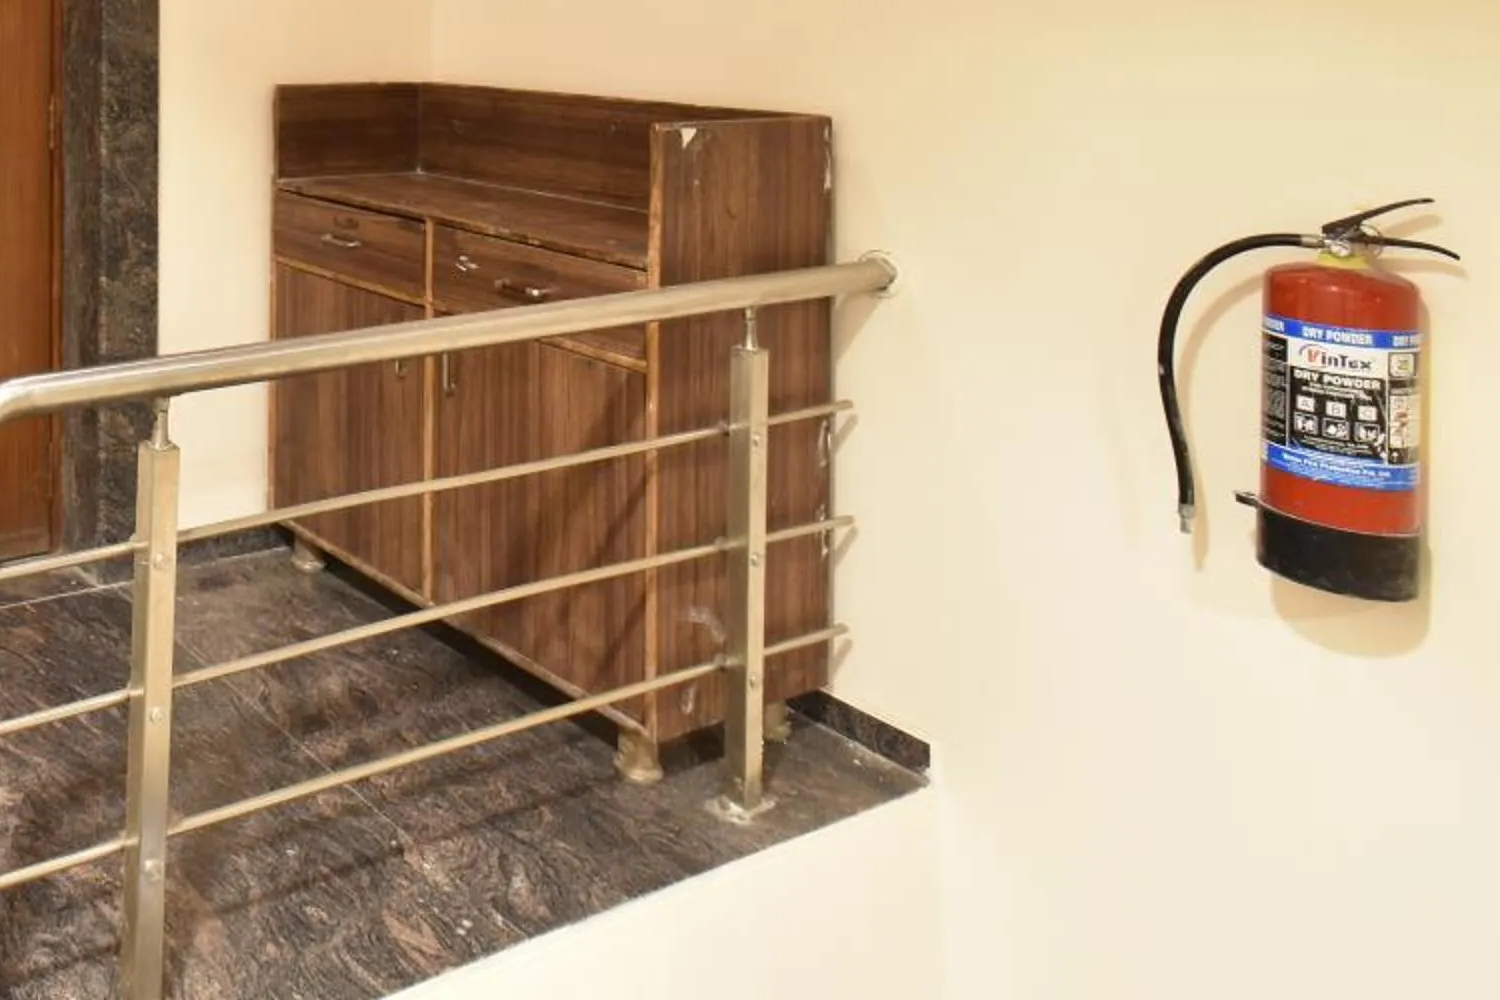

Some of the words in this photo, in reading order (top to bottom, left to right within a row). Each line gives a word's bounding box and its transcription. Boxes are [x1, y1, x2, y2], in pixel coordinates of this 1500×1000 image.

[1302, 326, 1324, 340] DRY
[1326, 329, 1372, 345] POWDER
[1307, 349, 1371, 369] VinTex
[1294, 368, 1319, 381] DRY
[1324, 374, 1380, 389] POWDER
